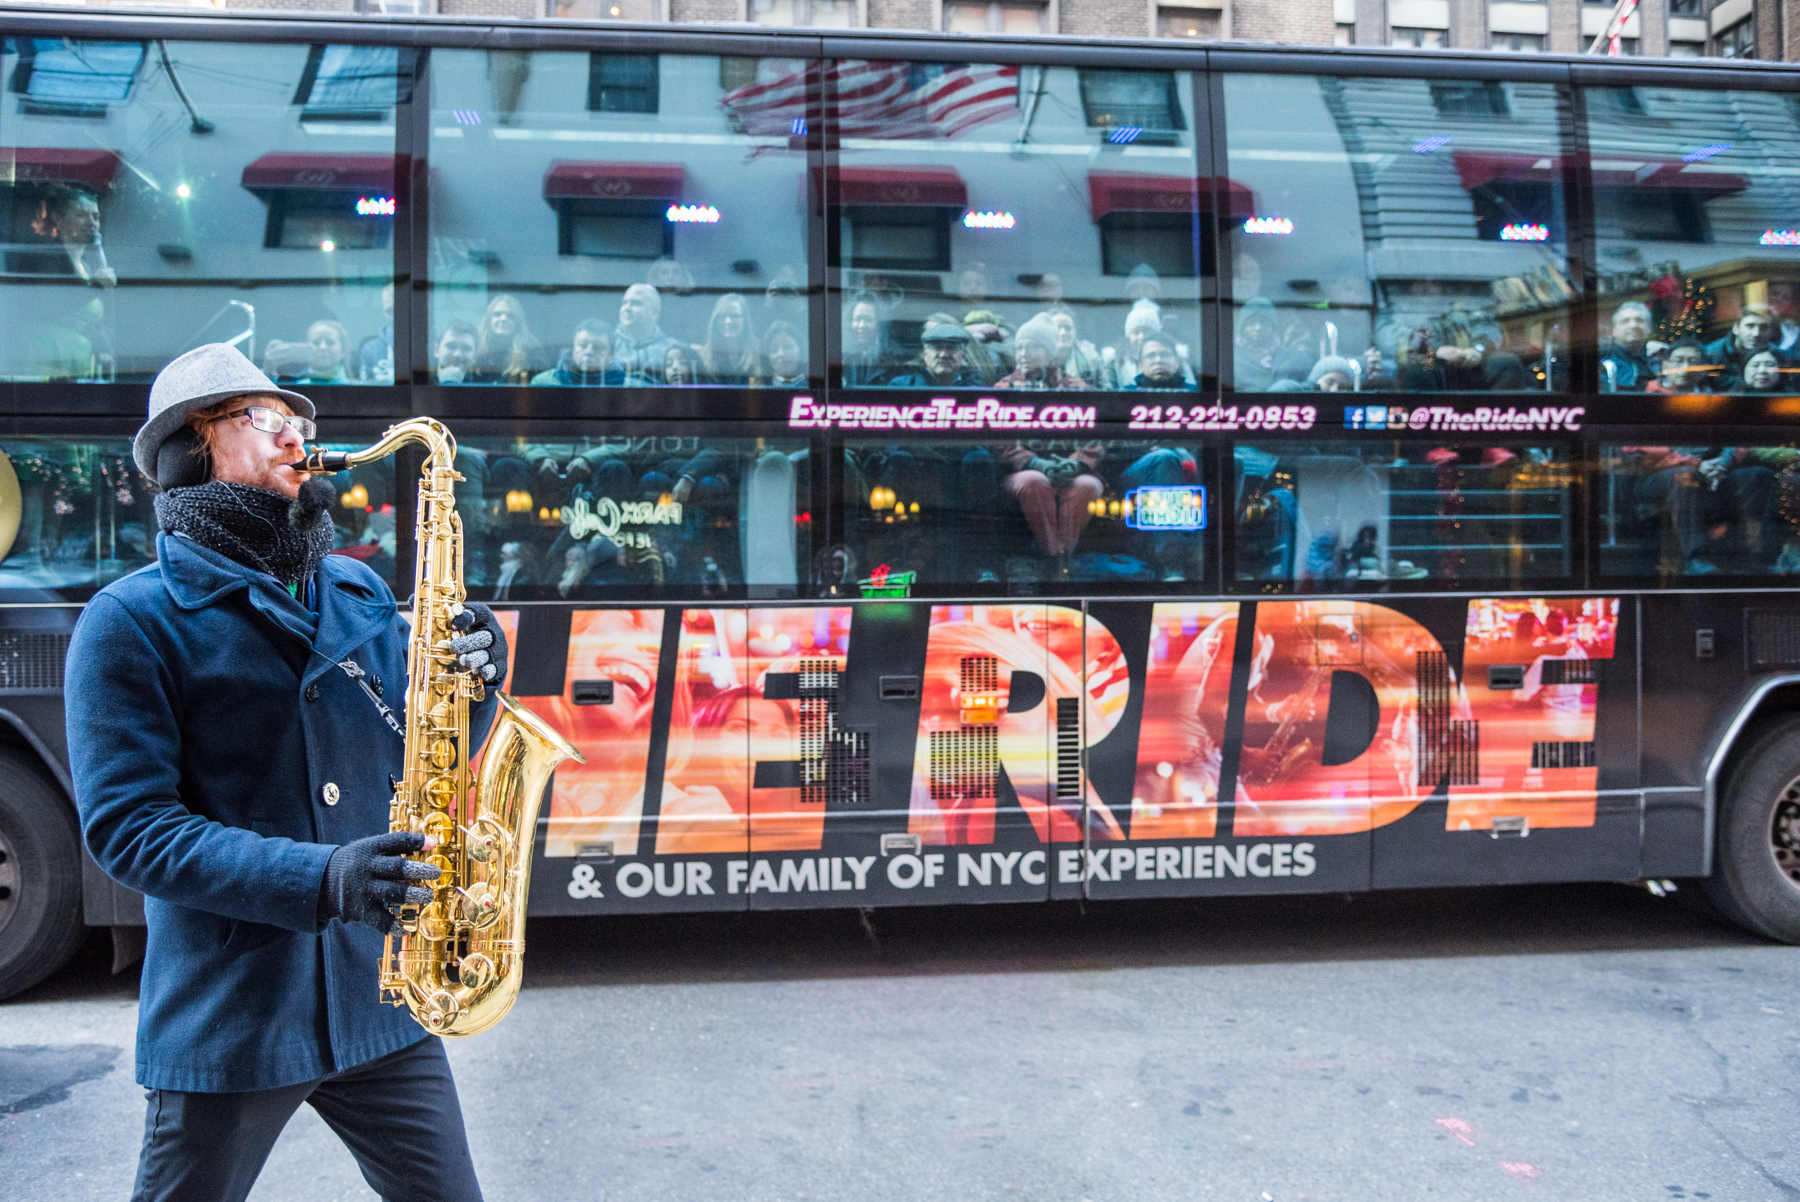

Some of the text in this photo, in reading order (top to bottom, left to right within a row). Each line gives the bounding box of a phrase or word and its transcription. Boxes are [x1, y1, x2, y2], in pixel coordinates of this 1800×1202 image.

[1128, 405, 1317, 430] 212-221-0853
[1408, 406, 1586, 430] @TheRideNYC
[907, 598, 1620, 846] RIDE
[567, 842, 1317, 899] & OUR FAMILY OF NYC EXPERIENCES
